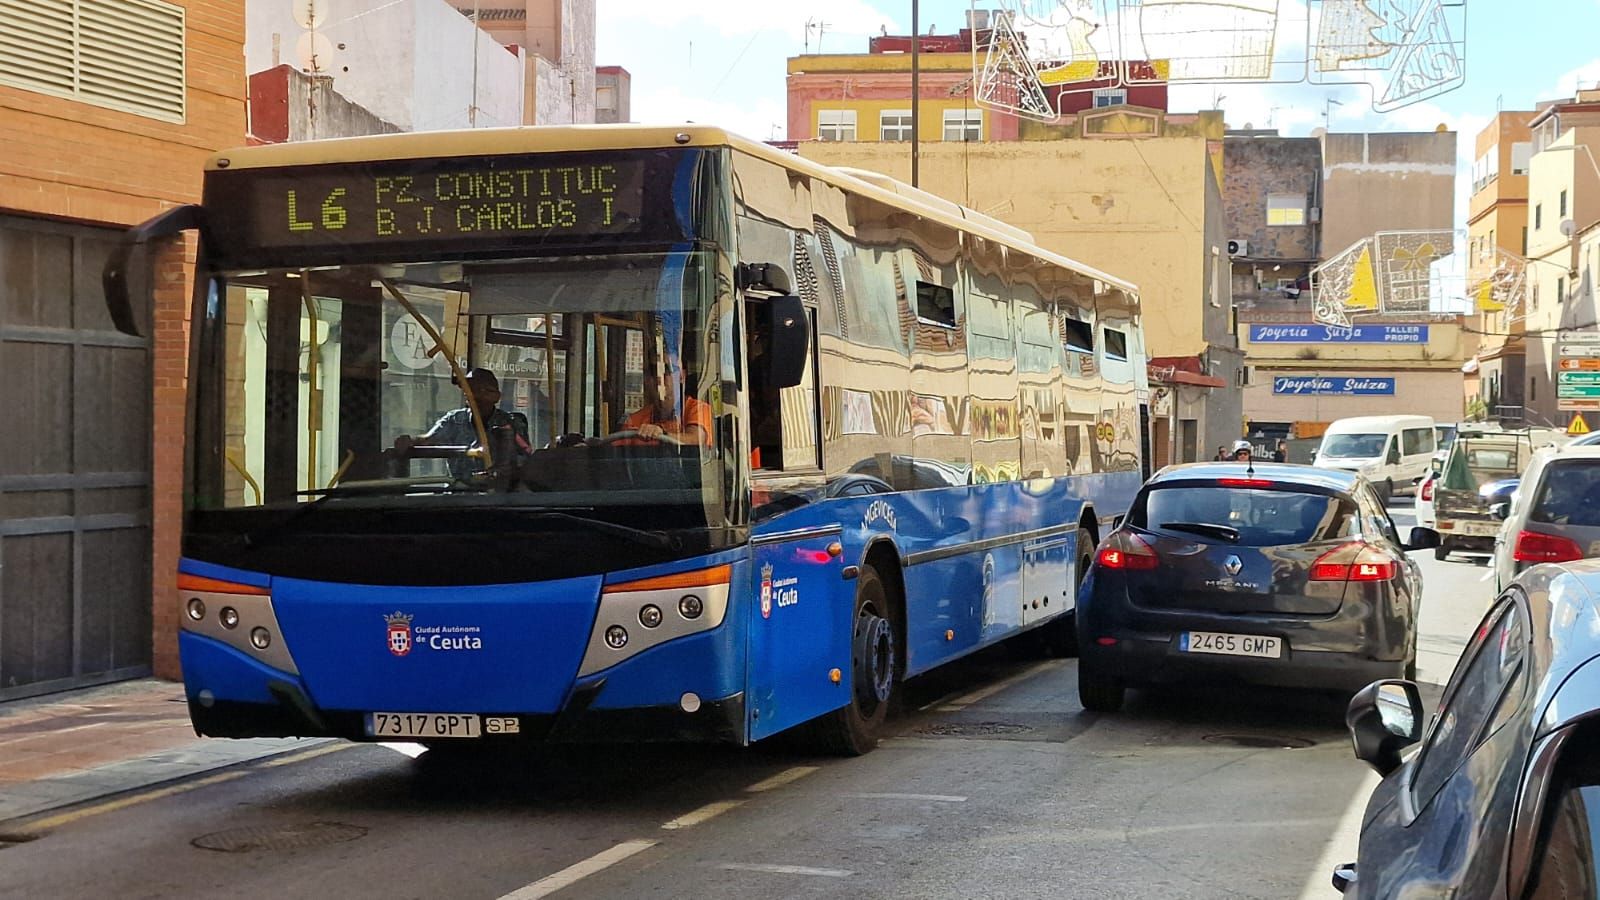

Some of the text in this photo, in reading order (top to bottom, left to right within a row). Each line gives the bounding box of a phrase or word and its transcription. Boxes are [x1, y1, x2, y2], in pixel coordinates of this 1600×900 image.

[376, 166, 616, 204] PZ. CONSTITUC
[377, 198, 613, 235] B. J. CARLOS I
[1384, 334, 1419, 342] PROPIO
[1385, 326, 1420, 334] TALLER
[1343, 379, 1389, 391] Suiza
[777, 587, 798, 607] Ceuta
[415, 625, 480, 634] Ciudad Autónoma
[415, 634, 482, 650] de Ceuta
[1193, 634, 1276, 654] 2465 GMP
[377, 714, 473, 735] 7317 GPT
[489, 719, 516, 733] SP
